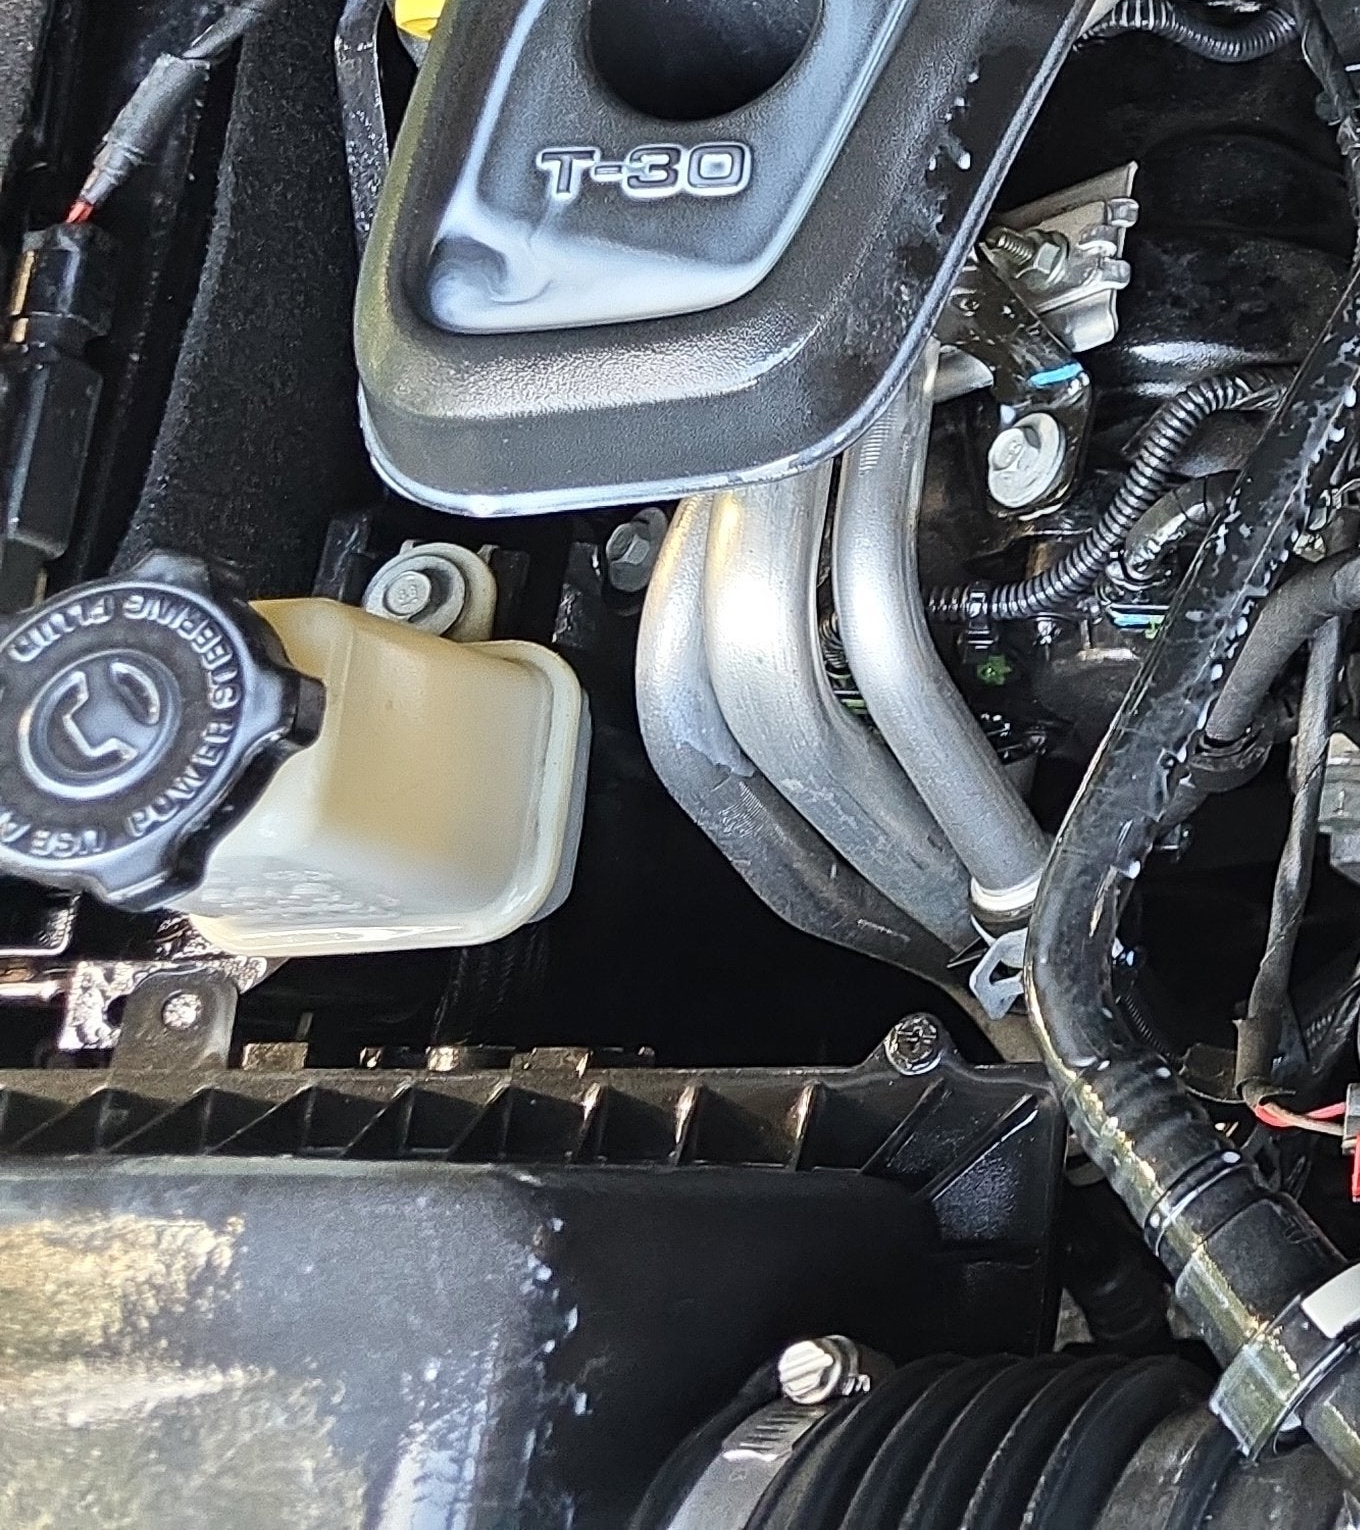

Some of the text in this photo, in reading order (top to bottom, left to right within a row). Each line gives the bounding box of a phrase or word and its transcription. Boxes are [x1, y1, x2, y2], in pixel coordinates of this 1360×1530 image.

[536, 142, 753, 200] T-30
[9, 594, 240, 837] POWER STEERING FLUID
[29, 830, 107, 857] USE
